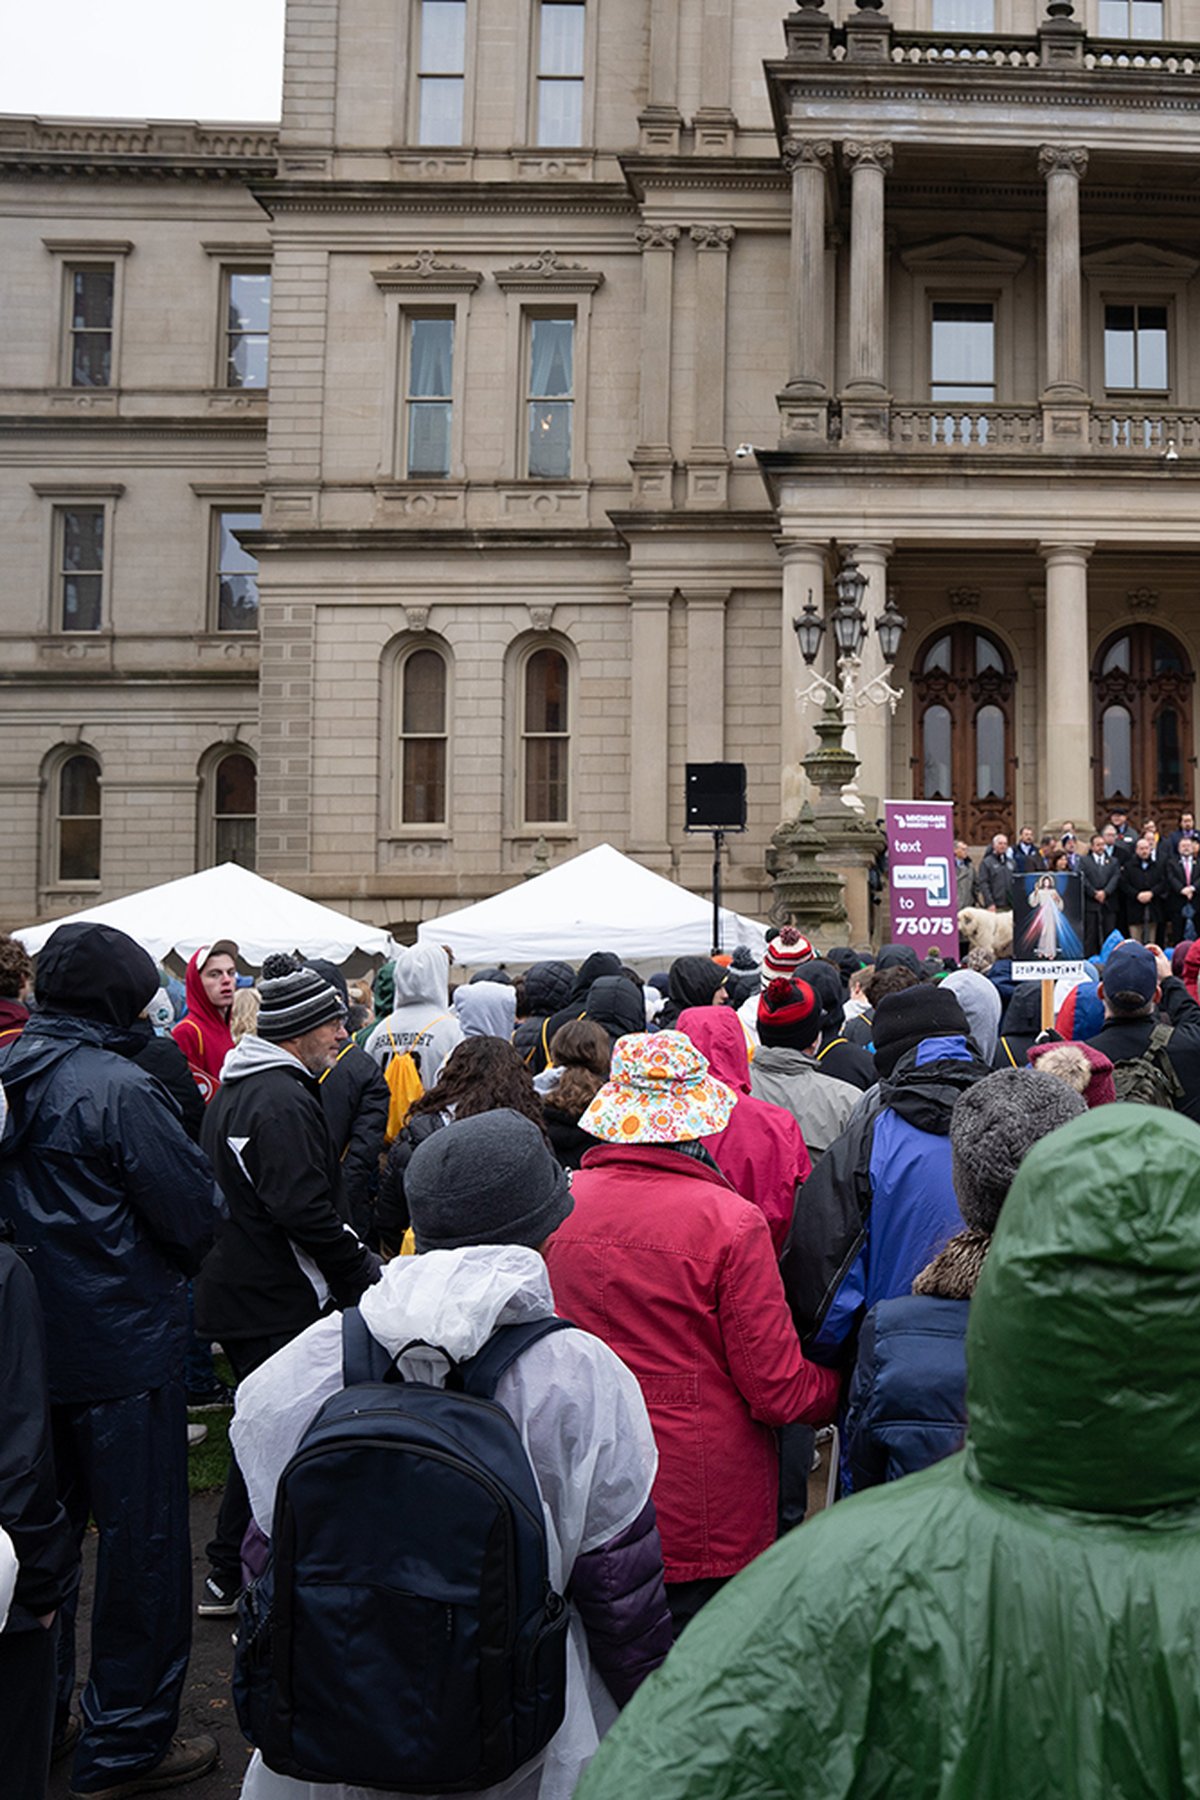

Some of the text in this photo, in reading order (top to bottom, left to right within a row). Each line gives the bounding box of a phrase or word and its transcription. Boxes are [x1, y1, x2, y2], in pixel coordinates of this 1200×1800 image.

[894, 840, 922, 853] text
[897, 873, 941, 881] MIMARCH
[899, 896, 915, 909] to
[895, 917, 954, 935] 73075
